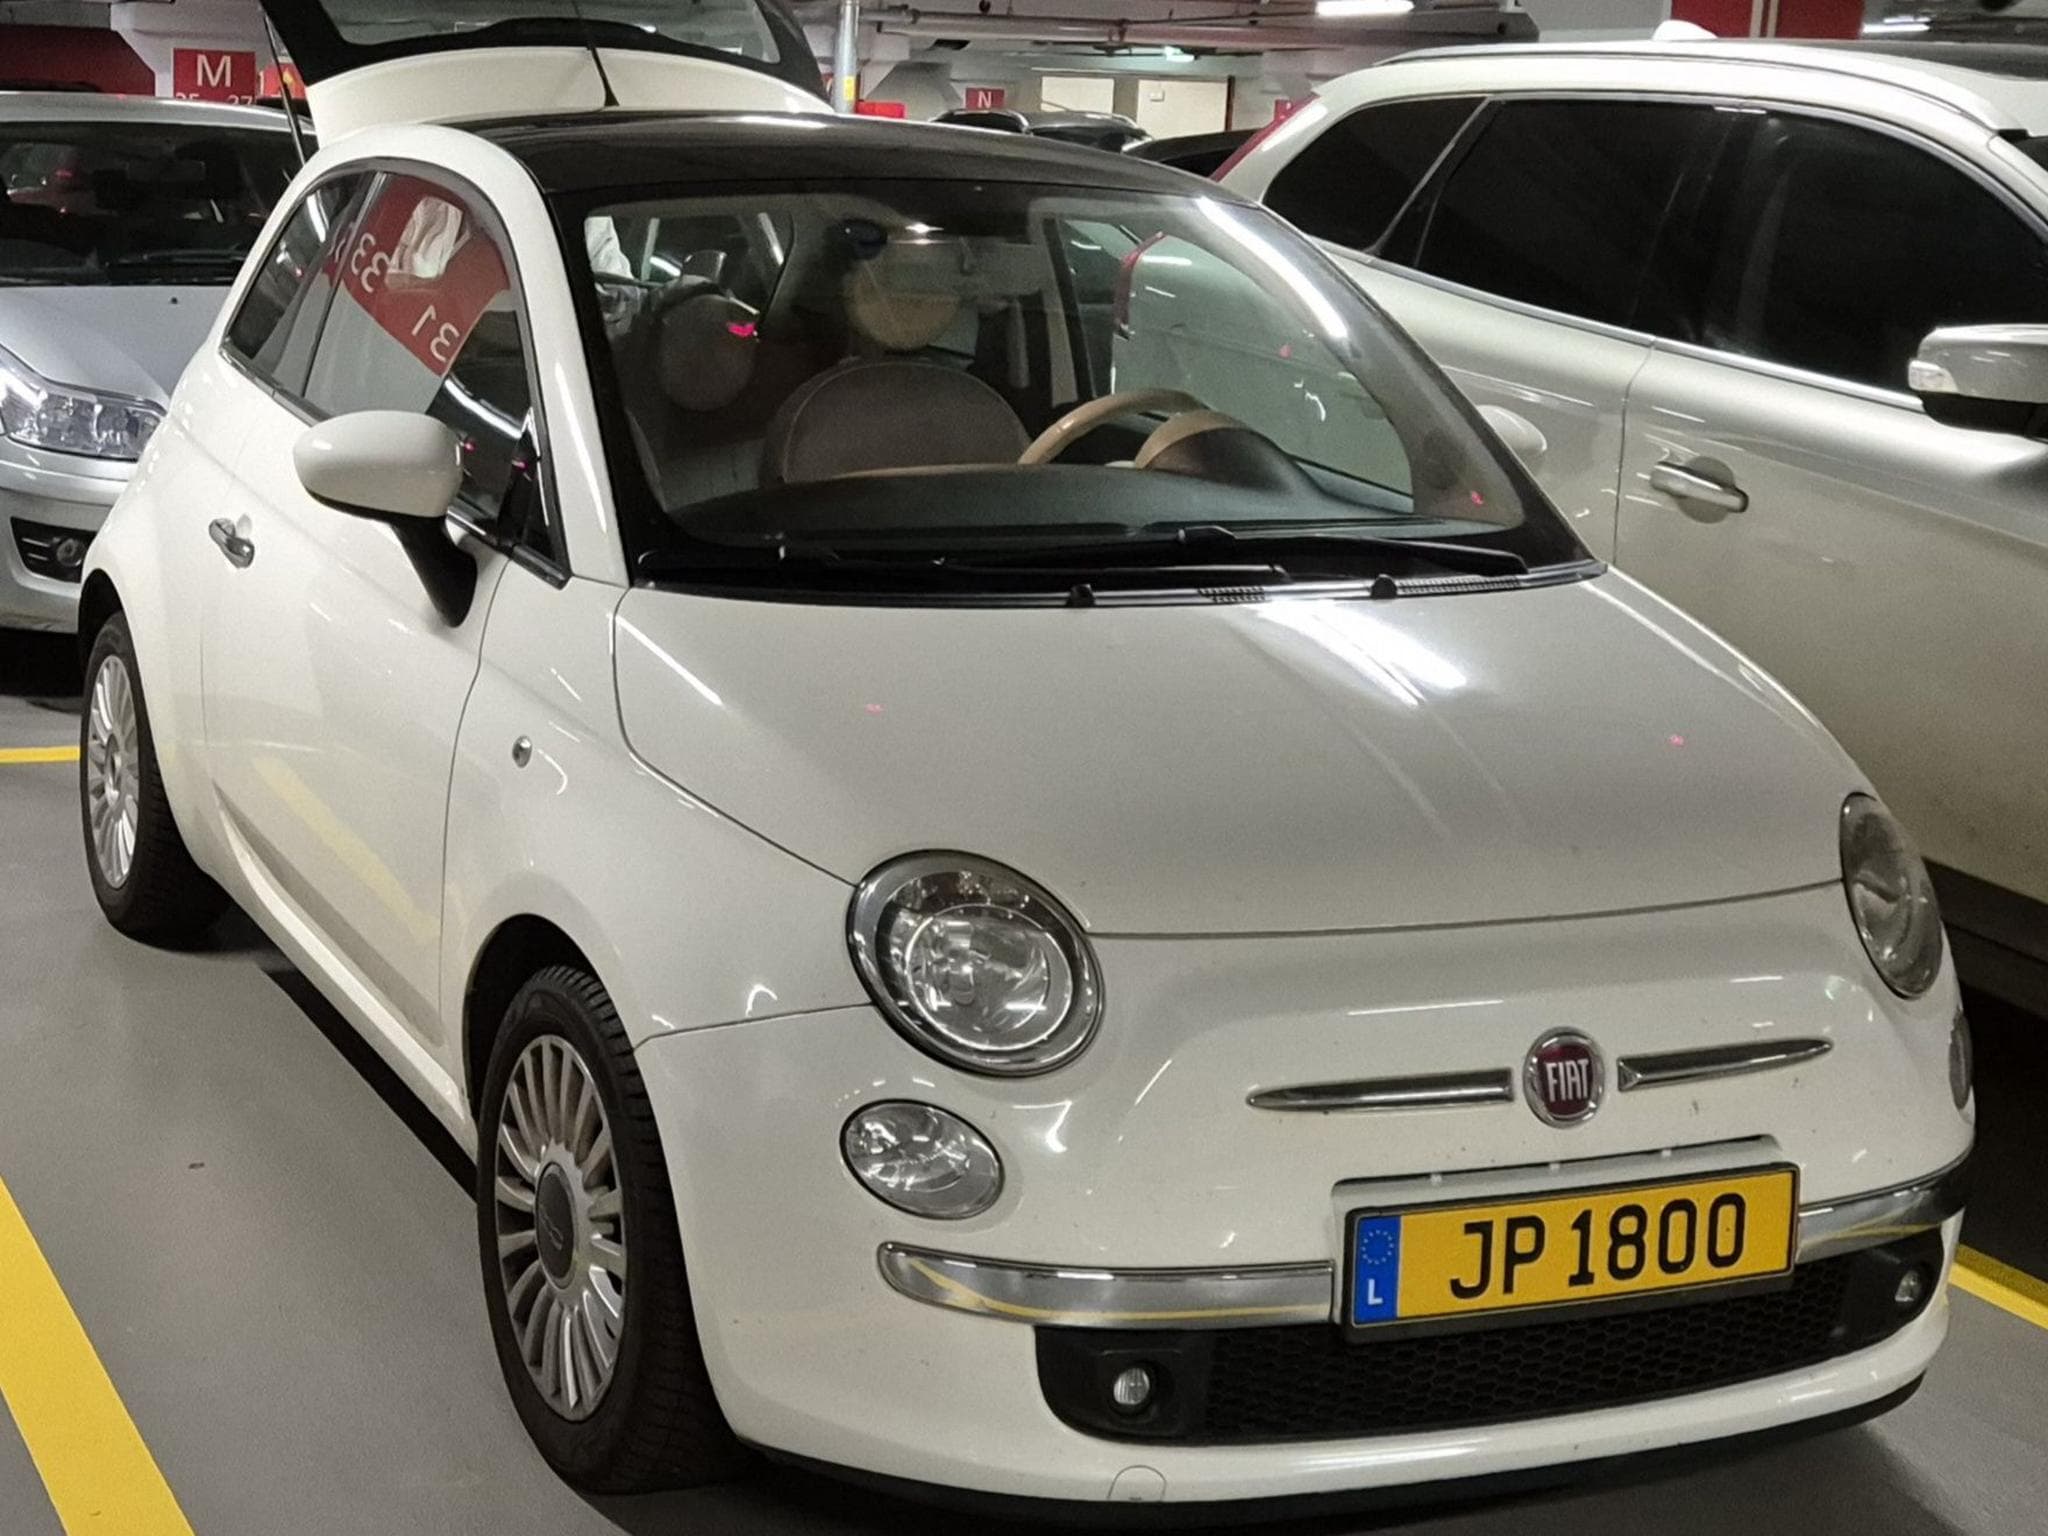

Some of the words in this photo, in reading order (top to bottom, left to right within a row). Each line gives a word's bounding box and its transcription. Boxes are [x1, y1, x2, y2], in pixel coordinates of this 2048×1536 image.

[196, 53, 232, 88] M
[977, 90, 992, 109] N
[1545, 1057, 1590, 1103] FIAT
[1449, 1214, 1546, 1300] JP
[1567, 1192, 1747, 1288] 1800
[1367, 1278, 1383, 1306] L
